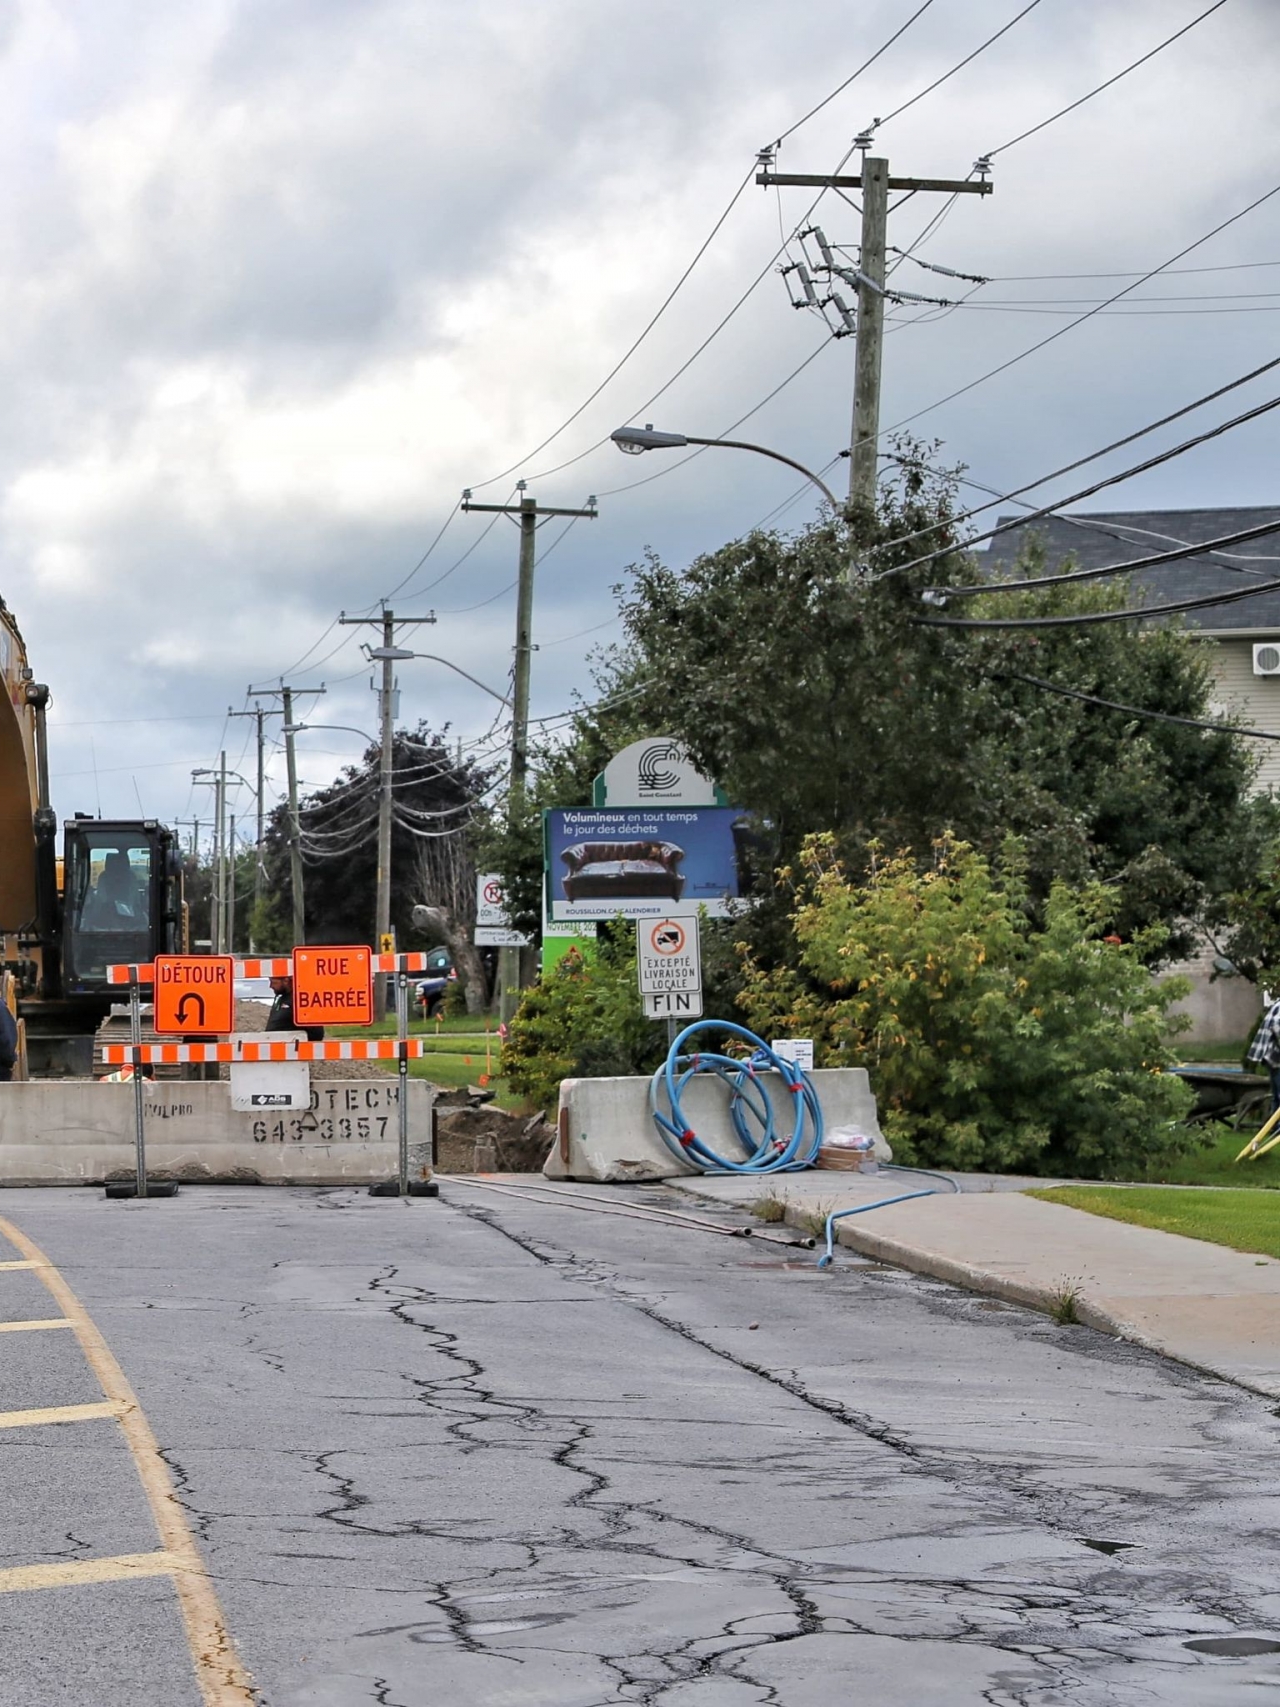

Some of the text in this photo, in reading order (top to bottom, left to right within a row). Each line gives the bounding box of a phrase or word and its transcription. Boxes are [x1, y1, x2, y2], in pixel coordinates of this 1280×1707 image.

[563, 812, 698, 824] Volumineux en tout temps
[563, 823, 658, 836] le jour des déchets
[316, 958, 349, 976] RUE
[647, 955, 691, 968] EXCEPTÉ
[162, 962, 226, 984] DÉTOUR
[644, 968, 695, 979] LIVRAISON
[652, 979, 687, 990] LOCALE
[299, 988, 367, 1008] BARRÉE
[653, 993, 690, 1012] FIN
